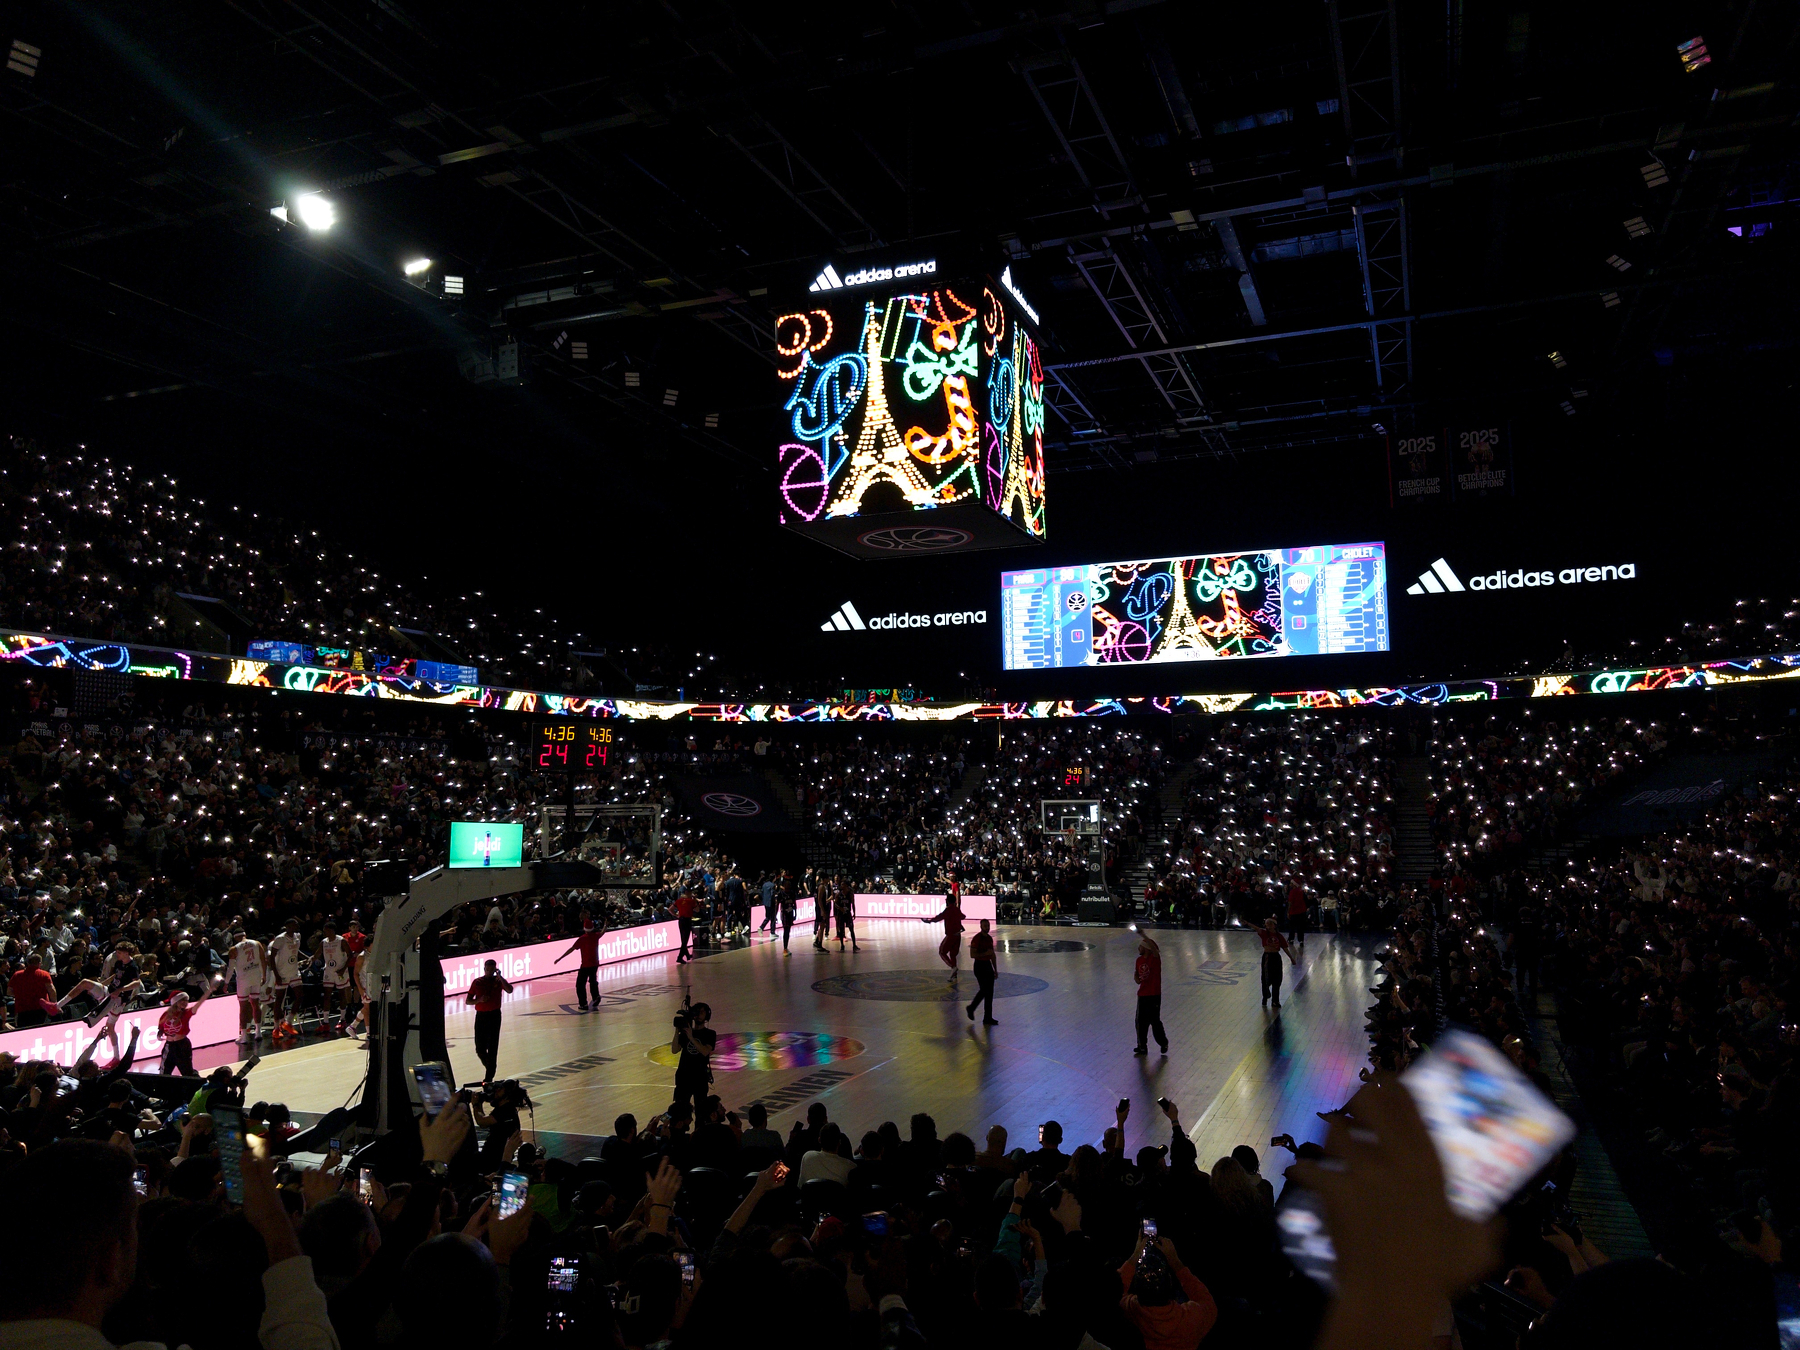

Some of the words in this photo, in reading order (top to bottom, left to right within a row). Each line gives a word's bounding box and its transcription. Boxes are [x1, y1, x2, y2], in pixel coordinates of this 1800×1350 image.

[844, 265, 893, 286] adidas
[894, 260, 936, 278] arena
[1398, 435, 1437, 456] 2025
[1459, 427, 1500, 449] 2025
[1398, 478, 1425, 489] FRENCH
[1425, 476, 1441, 487] CUP
[1457, 471, 1487, 483] BETCLIC
[1487, 469, 1507, 480] ELITE
[1399, 486, 1441, 497] CHAMPIONS
[1461, 478, 1505, 490] CHAMPIONS
[1298, 549, 1315, 563] 70
[1341, 547, 1374, 559] CHOLET
[1469, 568, 1555, 591] adidas
[1558, 563, 1636, 585] arena
[869, 611, 931, 630] adidas
[933, 610, 987, 627] arena
[544, 726, 575, 741] 4:36
[589, 727, 612, 743] 4:36
[539, 744, 569, 766] 24
[586, 744, 608, 766] 24
[1064, 774, 1080, 785] 24
[1081, 895, 1111, 903] nutribullet
[401, 904, 427, 935] SPALDING
